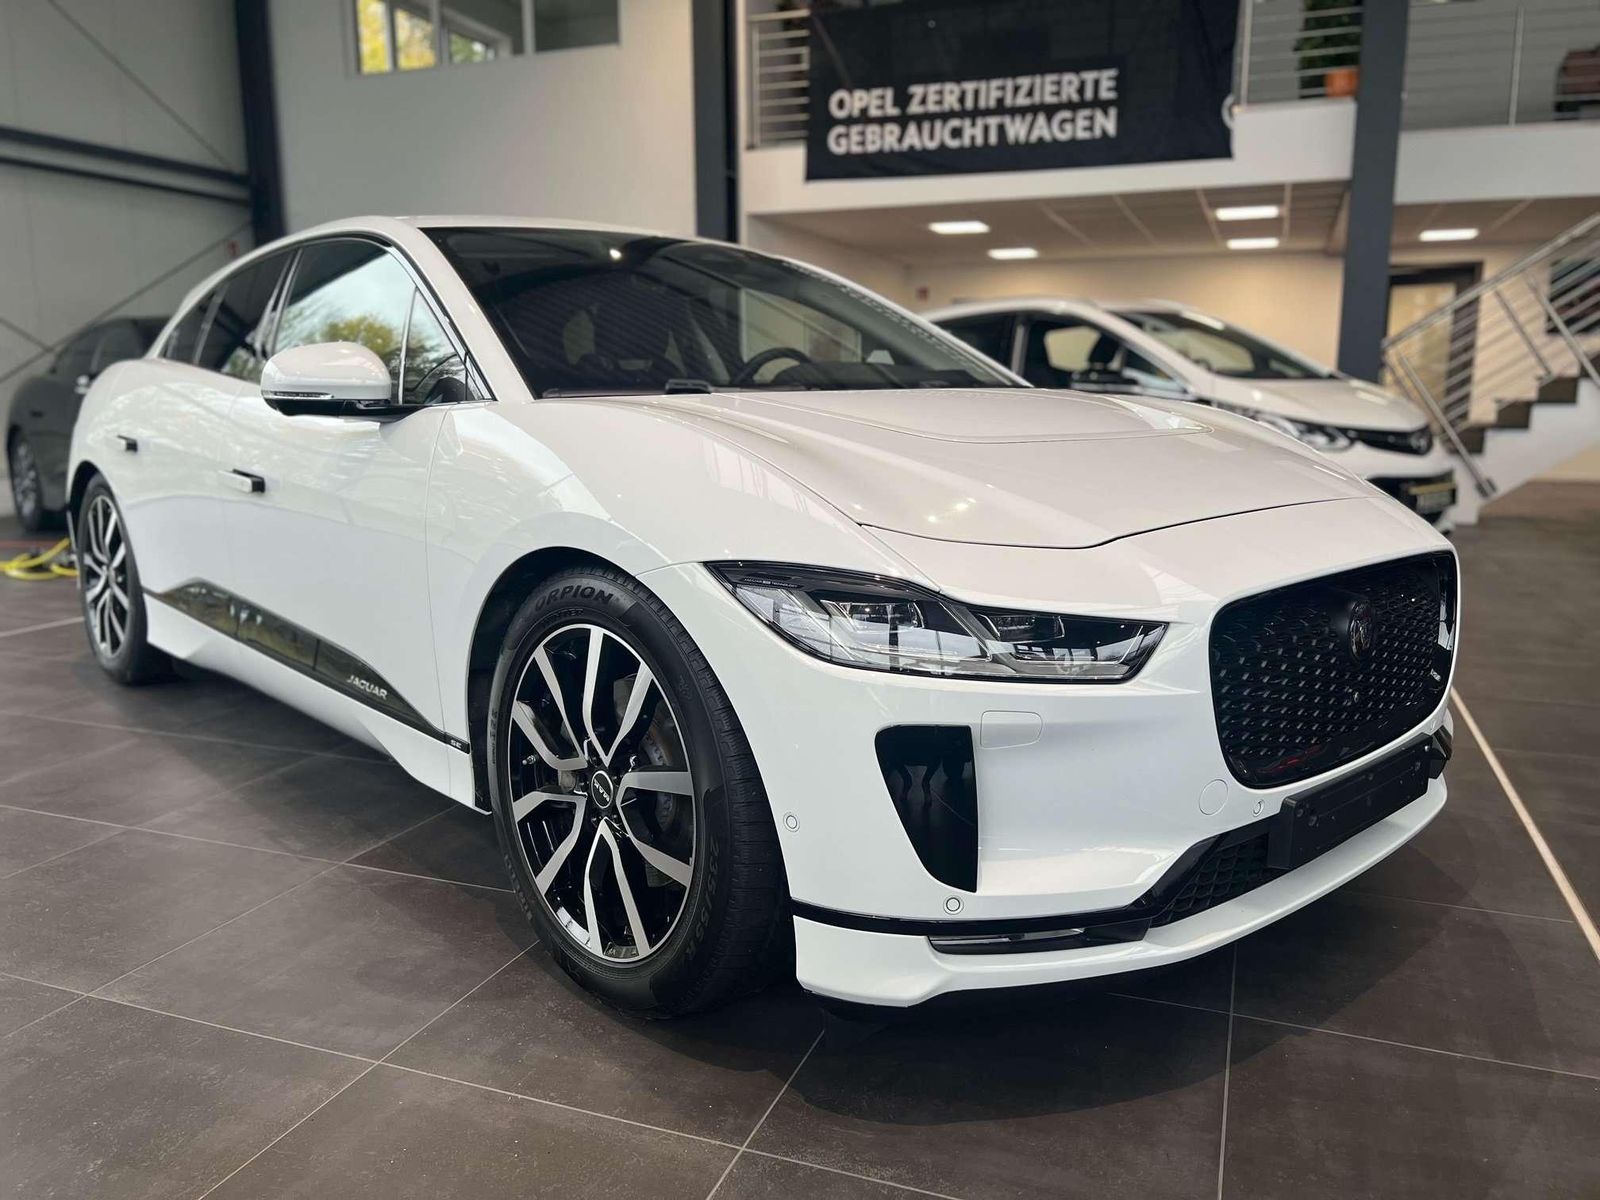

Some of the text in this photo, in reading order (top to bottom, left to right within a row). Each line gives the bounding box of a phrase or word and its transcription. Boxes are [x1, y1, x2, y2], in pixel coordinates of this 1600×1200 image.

[828, 68, 1118, 119] OPEL ZERTIFIZIERTE
[827, 107, 1118, 155] GEBRAUCHTWAGEN
[346, 674, 388, 700] JAGUAR
